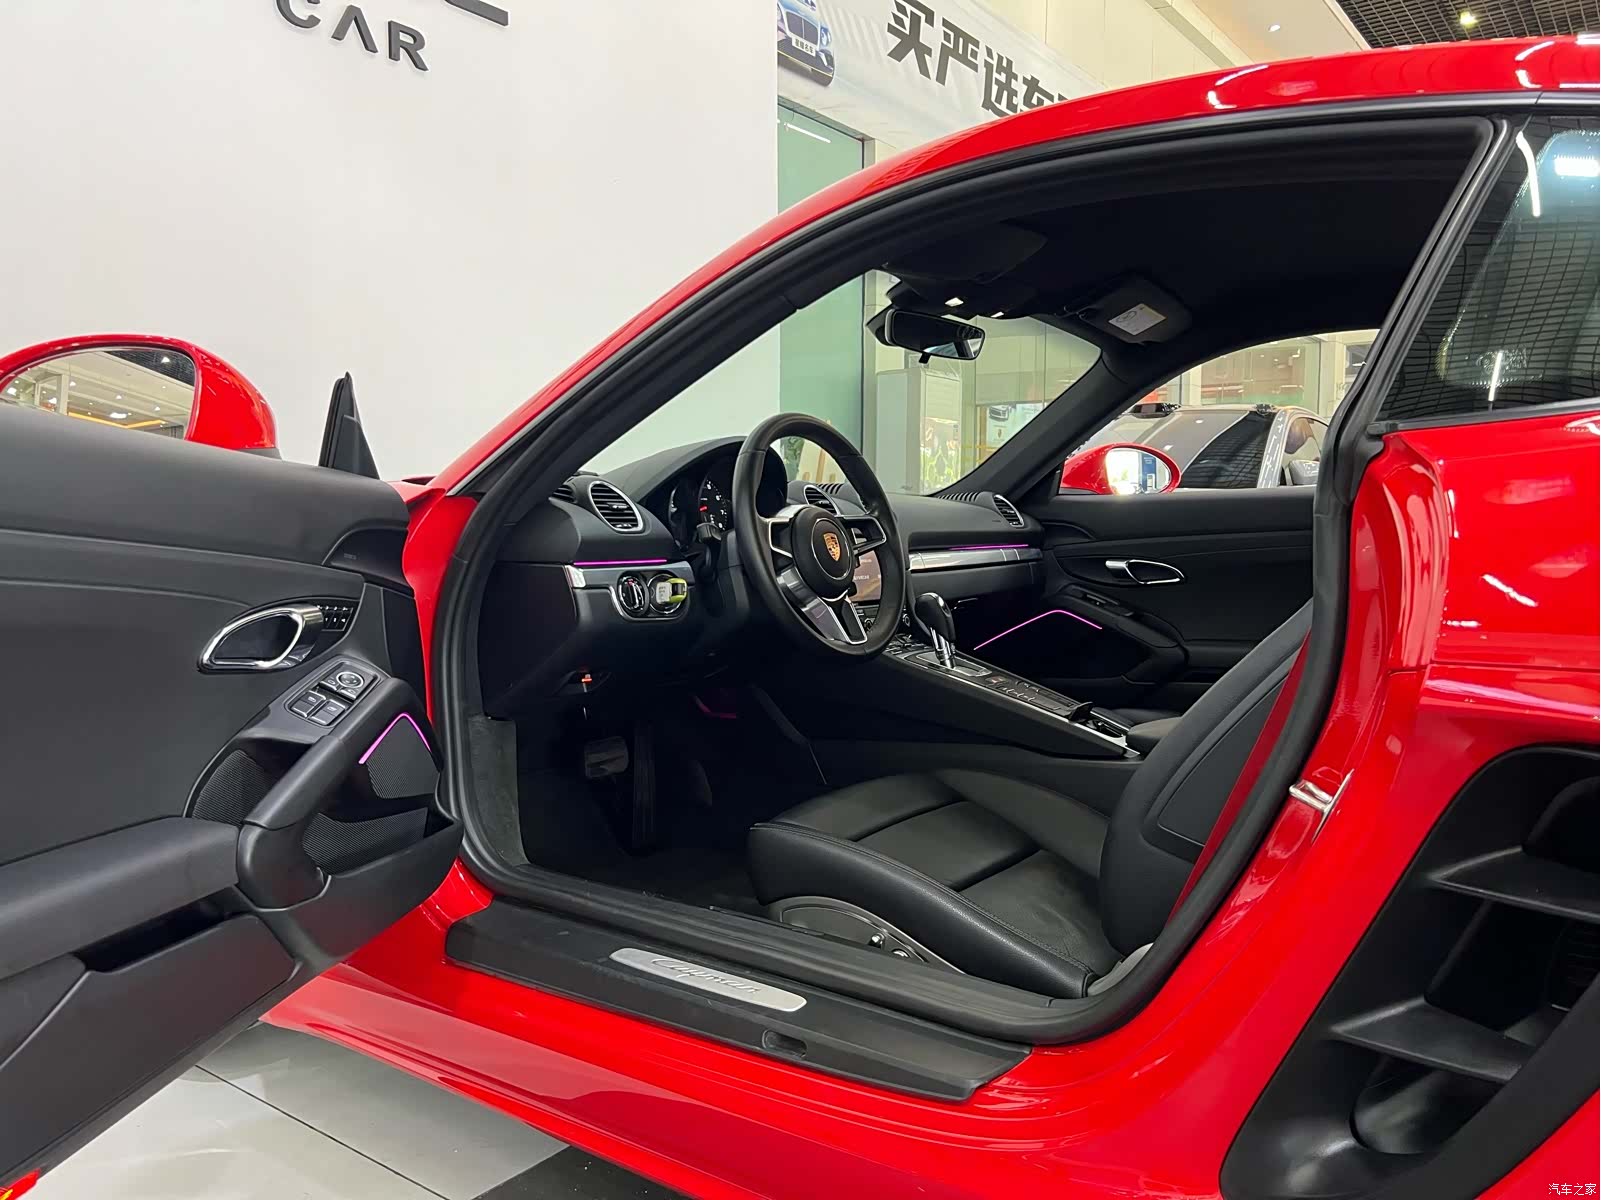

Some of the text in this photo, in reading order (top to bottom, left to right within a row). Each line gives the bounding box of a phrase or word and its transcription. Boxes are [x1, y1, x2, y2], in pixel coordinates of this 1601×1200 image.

[276, 0, 428, 71] CAR
[887, 0, 1068, 117] 买严选车
[651, 958, 761, 993] Cayman
